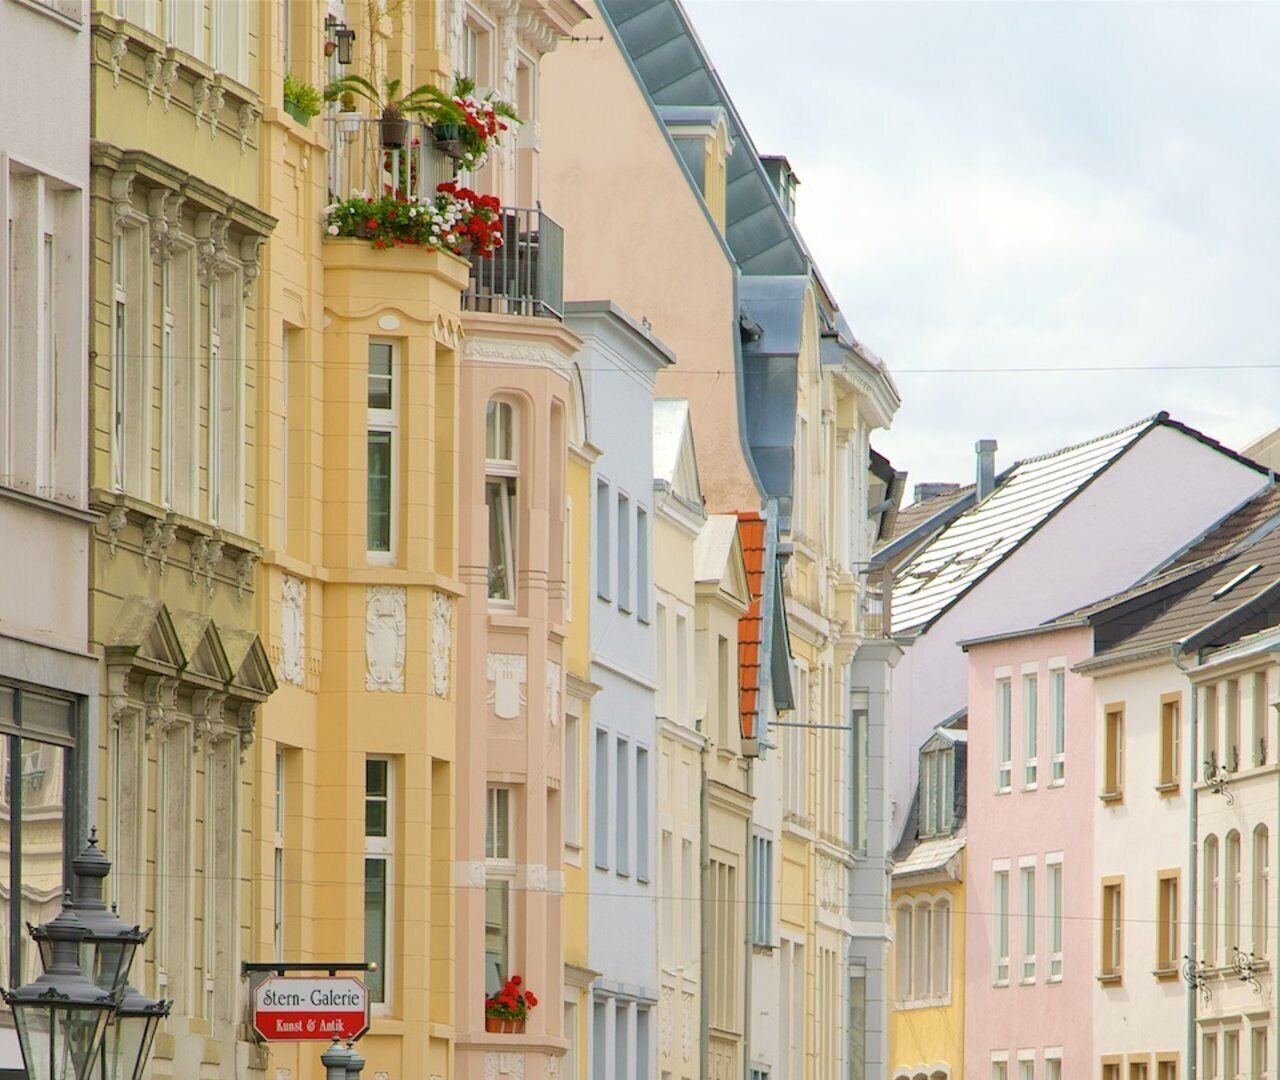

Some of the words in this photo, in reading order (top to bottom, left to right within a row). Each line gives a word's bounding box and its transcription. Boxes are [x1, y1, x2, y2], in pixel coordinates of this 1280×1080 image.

[263, 989, 305, 1006] Stern-
[310, 989, 360, 1006] Galerie
[276, 1018, 303, 1033] Kunst
[306, 1018, 317, 1033] &
[319, 1018, 345, 1033] Antik
